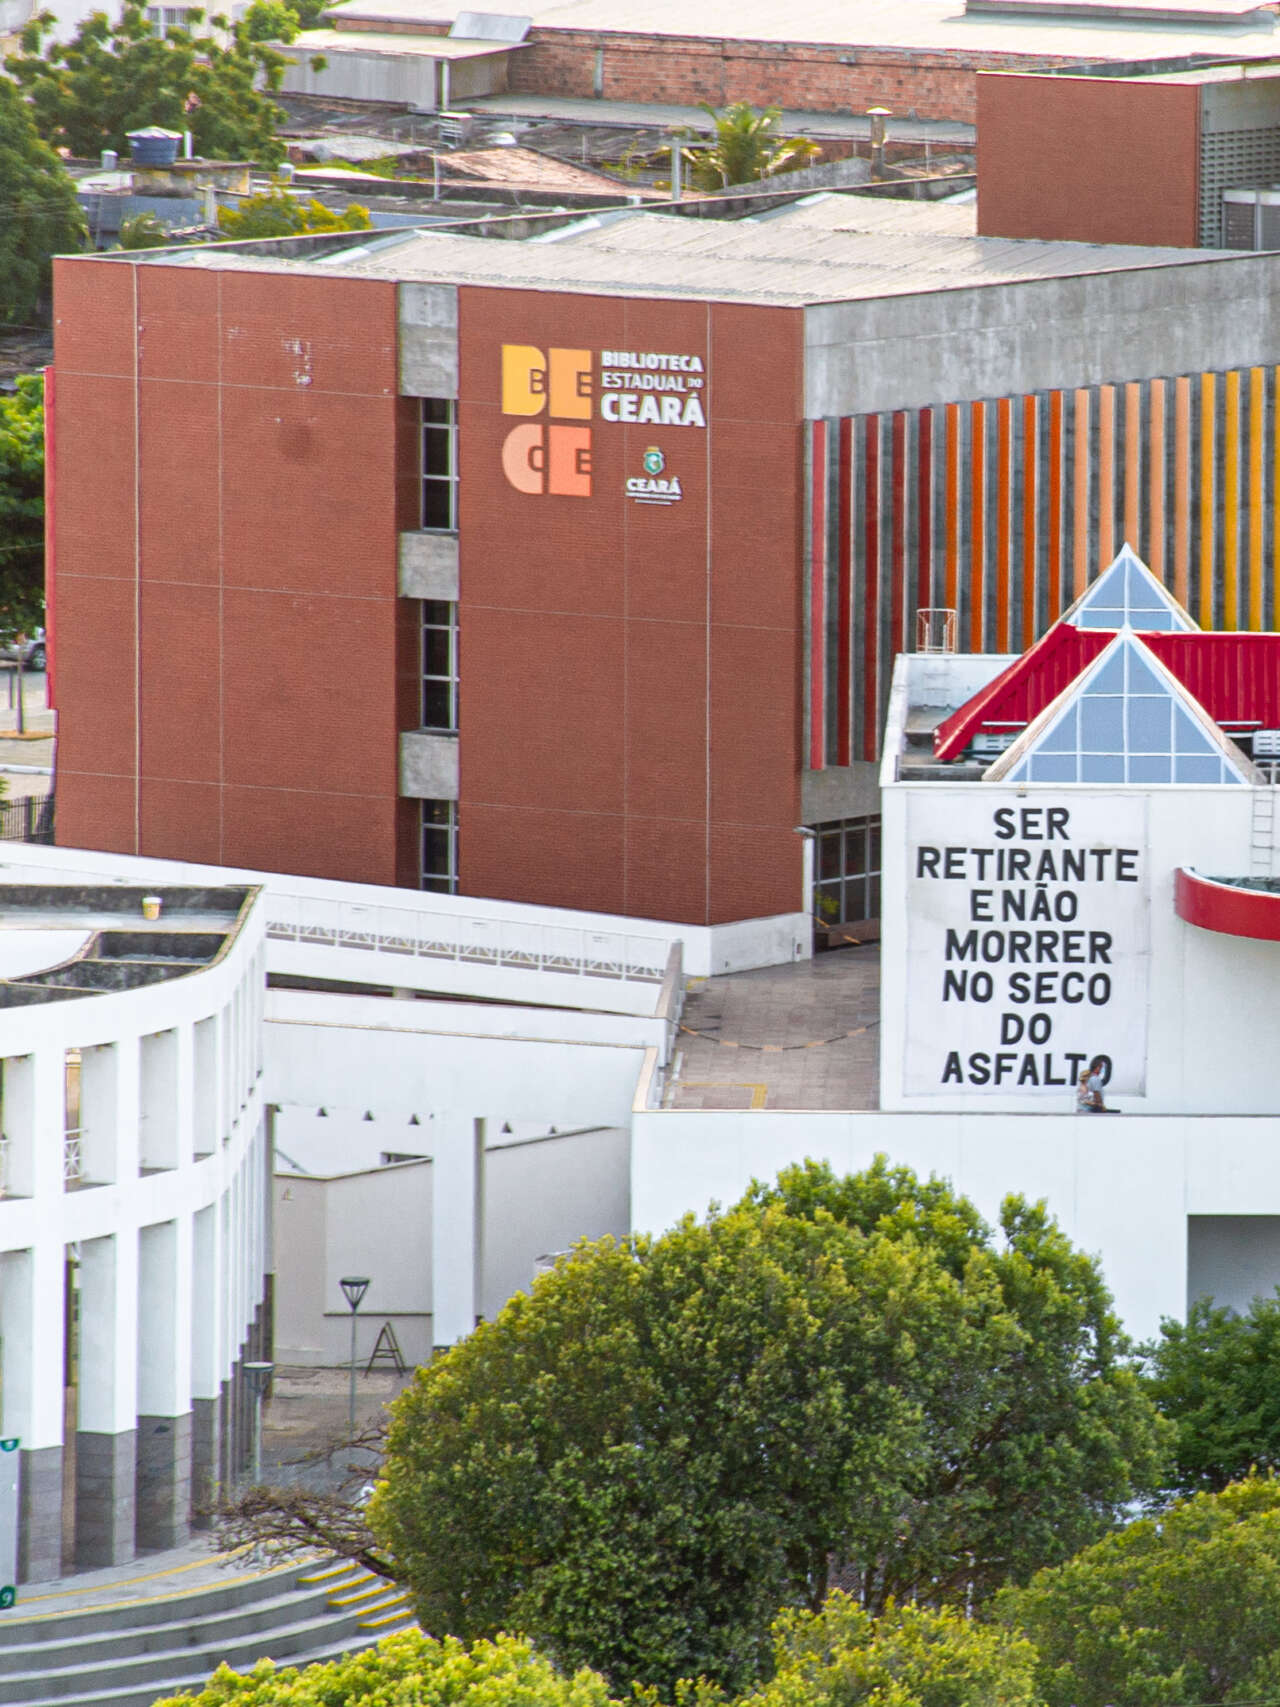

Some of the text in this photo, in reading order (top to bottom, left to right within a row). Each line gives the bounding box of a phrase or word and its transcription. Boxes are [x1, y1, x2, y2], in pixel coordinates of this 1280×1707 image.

[601, 351, 704, 372] BIBLIOTECA
[602, 372, 688, 392] ESTADUAL
[601, 392, 706, 427] CEARÁ
[626, 476, 682, 494] CEARÁ
[993, 807, 1070, 840] SER
[917, 846, 1138, 882] RETIRANTE
[970, 882, 1078, 922] E NÃO
[945, 928, 1112, 964] MORRER
[942, 969, 1111, 1006] NO SECO
[1000, 1012, 1052, 1045] DO
